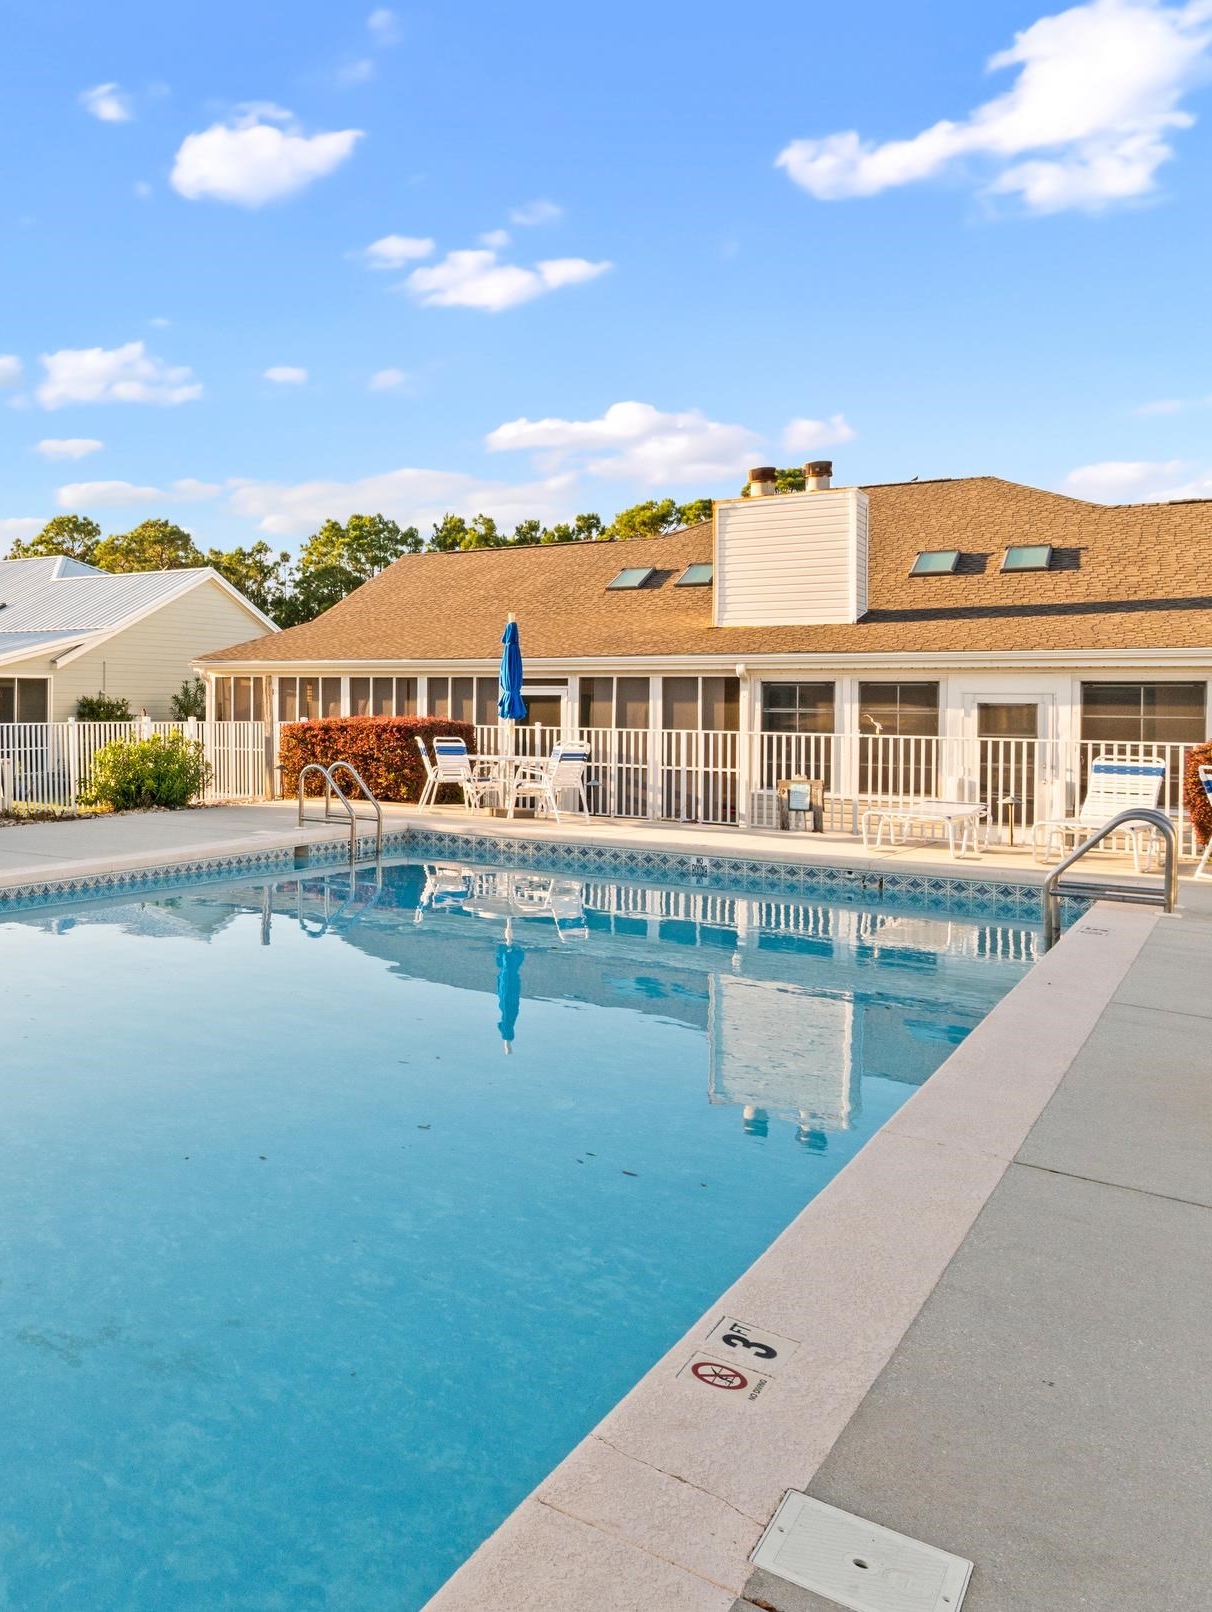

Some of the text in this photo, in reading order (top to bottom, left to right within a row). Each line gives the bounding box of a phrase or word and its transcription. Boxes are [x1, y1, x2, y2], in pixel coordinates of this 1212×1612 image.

[722, 1322, 778, 1360] 3 FT
[748, 1392, 758, 1401] NO
